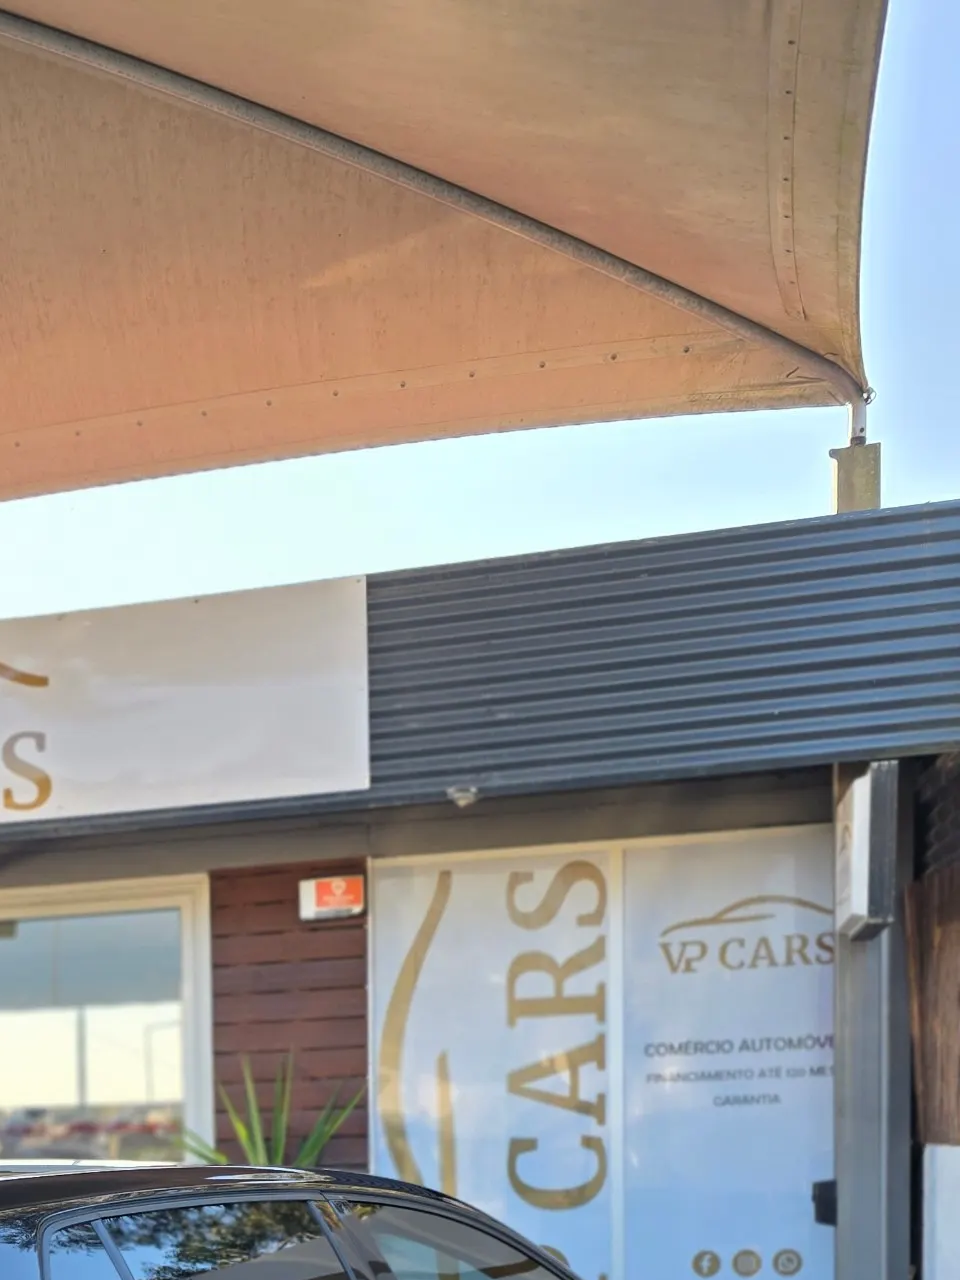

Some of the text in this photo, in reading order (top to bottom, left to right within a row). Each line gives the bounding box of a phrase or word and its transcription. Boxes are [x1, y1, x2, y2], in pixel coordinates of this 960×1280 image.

[658, 931, 835, 975] VP CARS
[505, 859, 608, 1212] CARS
[643, 1037, 735, 1058] COMÉRCIO
